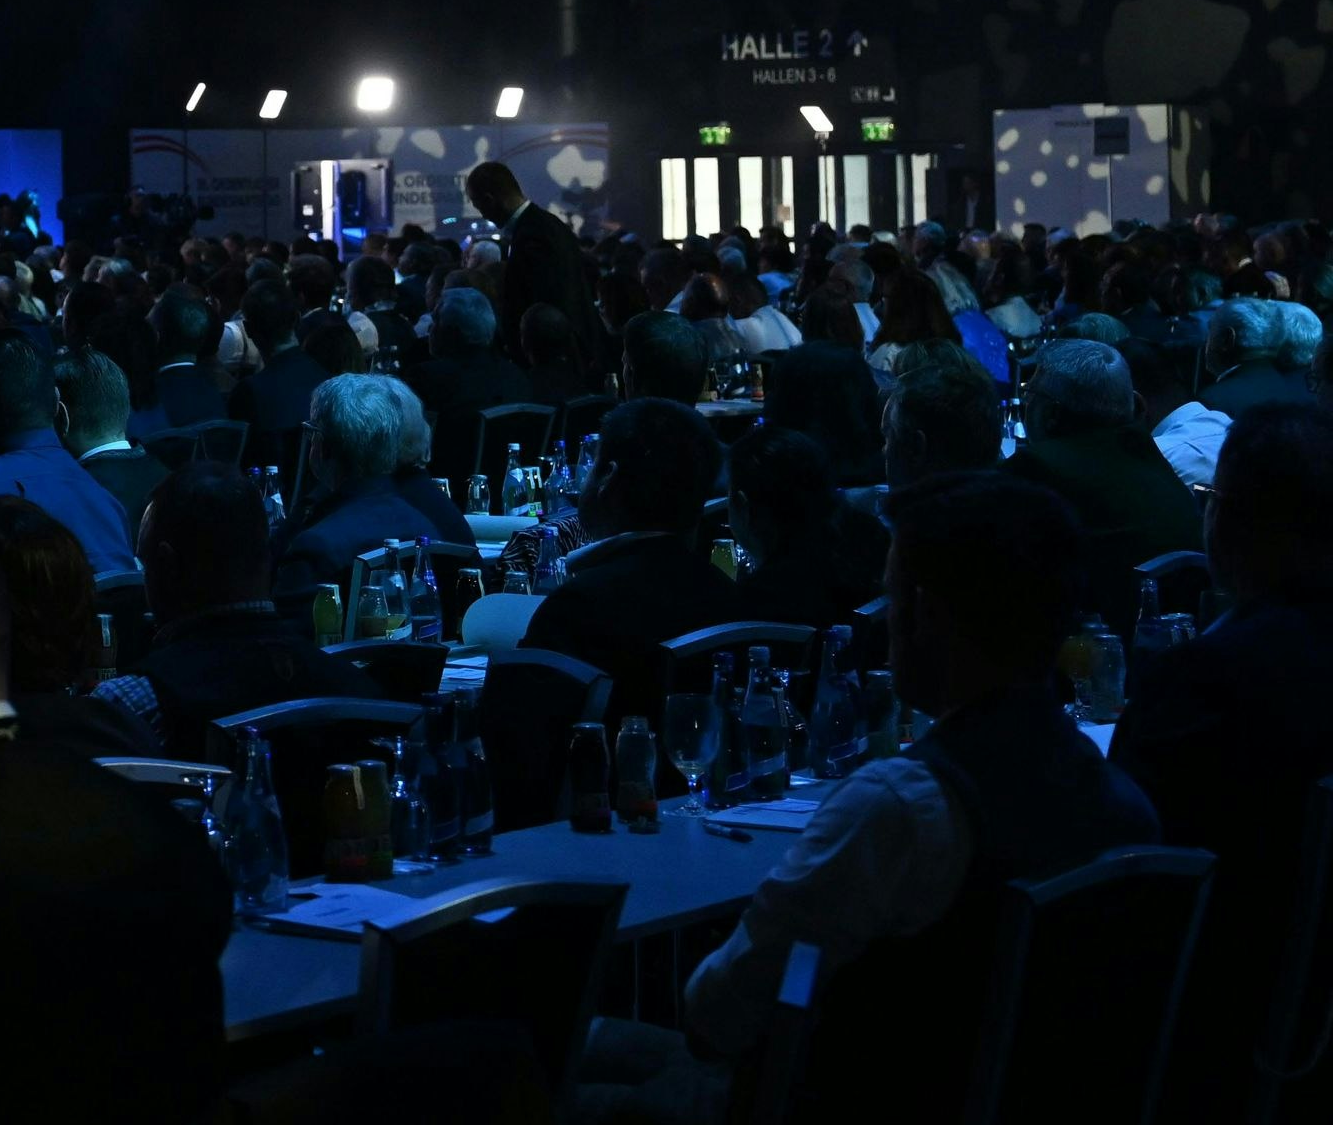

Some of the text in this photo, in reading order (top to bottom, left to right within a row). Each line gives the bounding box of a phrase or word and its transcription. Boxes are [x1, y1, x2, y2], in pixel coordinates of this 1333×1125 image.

[721, 28, 834, 61] HALLE 2
[752, 67, 807, 85] HALLEN
